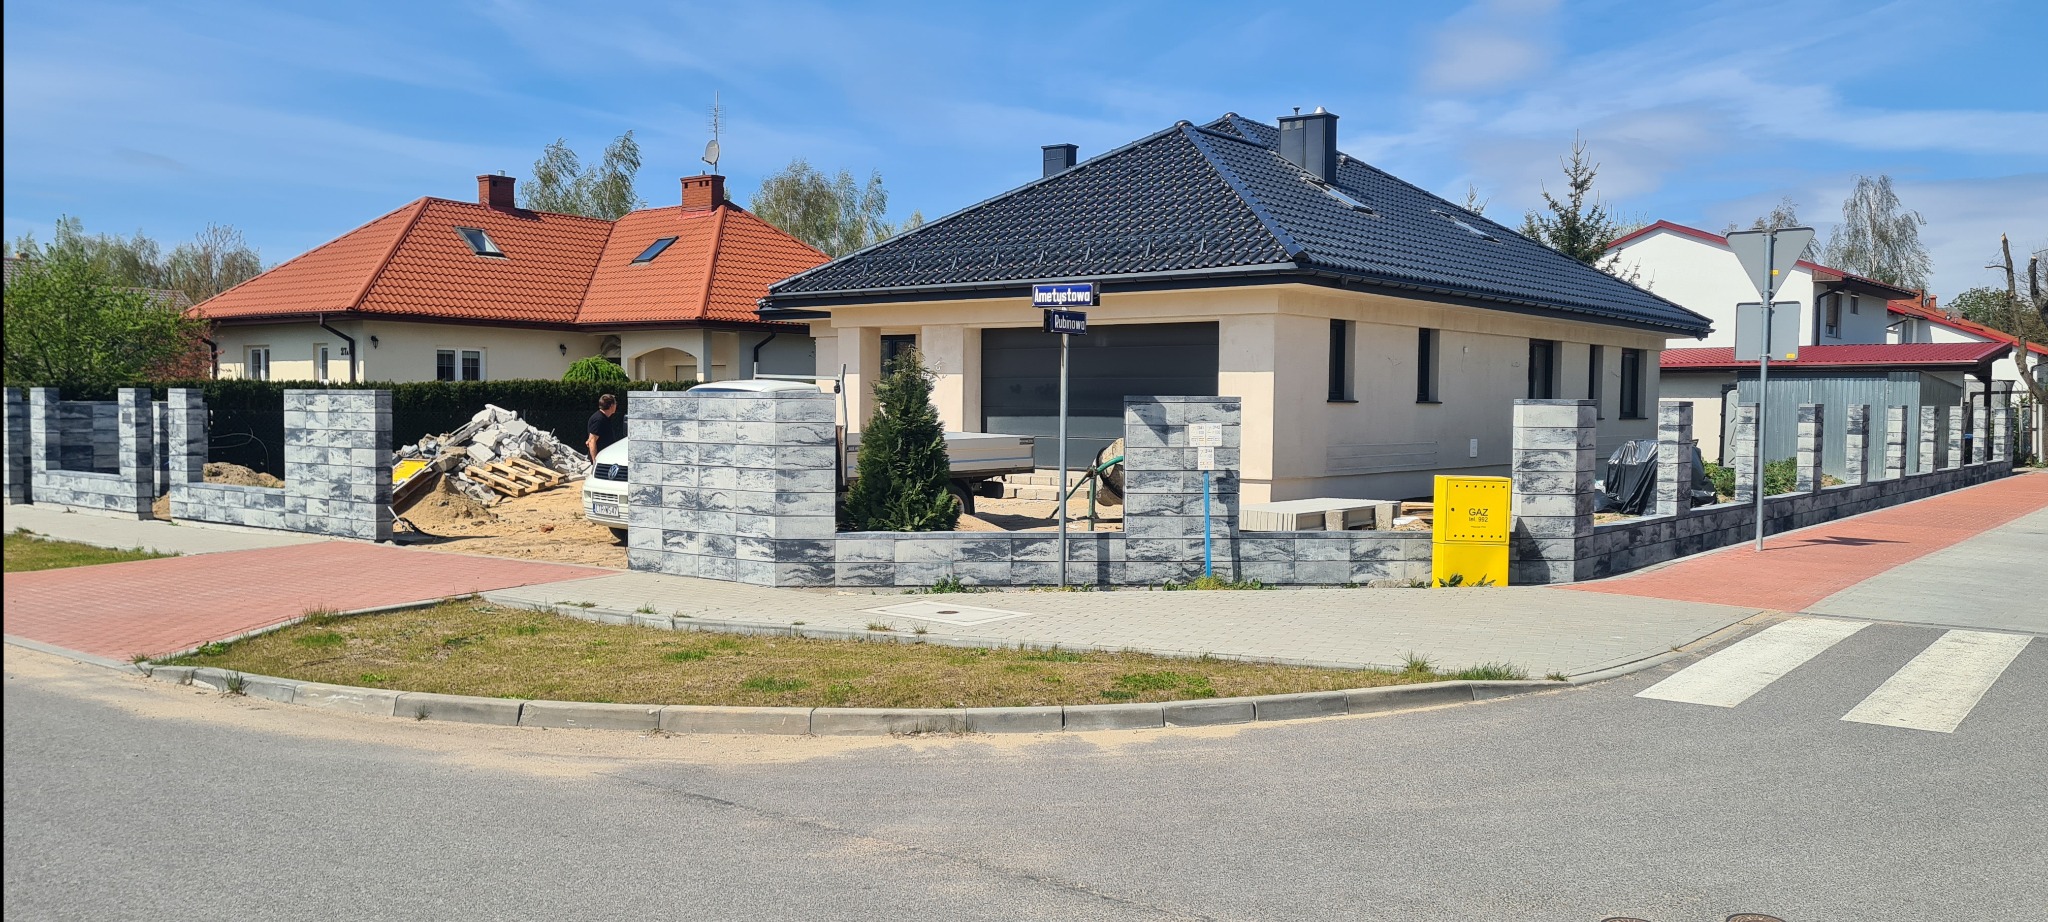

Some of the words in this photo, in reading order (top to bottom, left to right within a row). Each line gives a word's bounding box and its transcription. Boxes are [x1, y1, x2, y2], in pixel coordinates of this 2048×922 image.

[1034, 286, 1091, 305] Ametystowa
[1054, 314, 1085, 331] Rubinowa
[1468, 508, 1489, 516] GAZ
